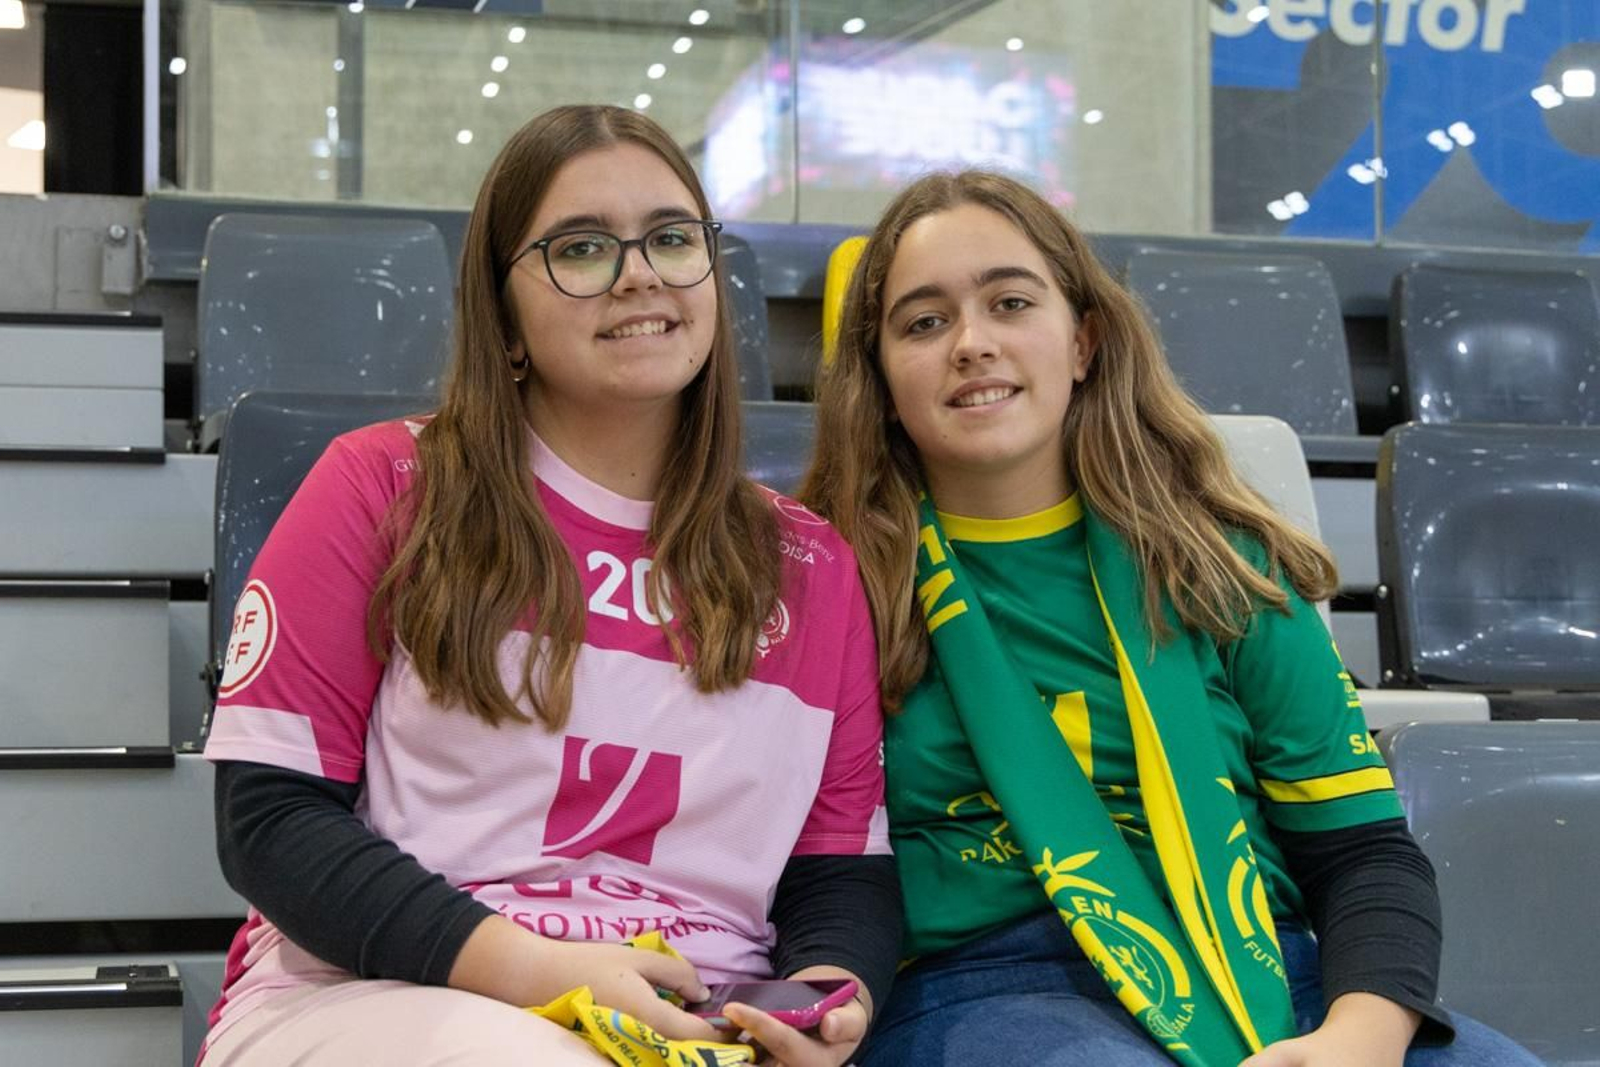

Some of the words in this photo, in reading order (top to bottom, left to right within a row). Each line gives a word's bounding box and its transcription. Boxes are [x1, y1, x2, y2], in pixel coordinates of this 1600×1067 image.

[586, 550, 674, 626] 20
[226, 642, 251, 665] F
[1348, 731, 1380, 756] SA
